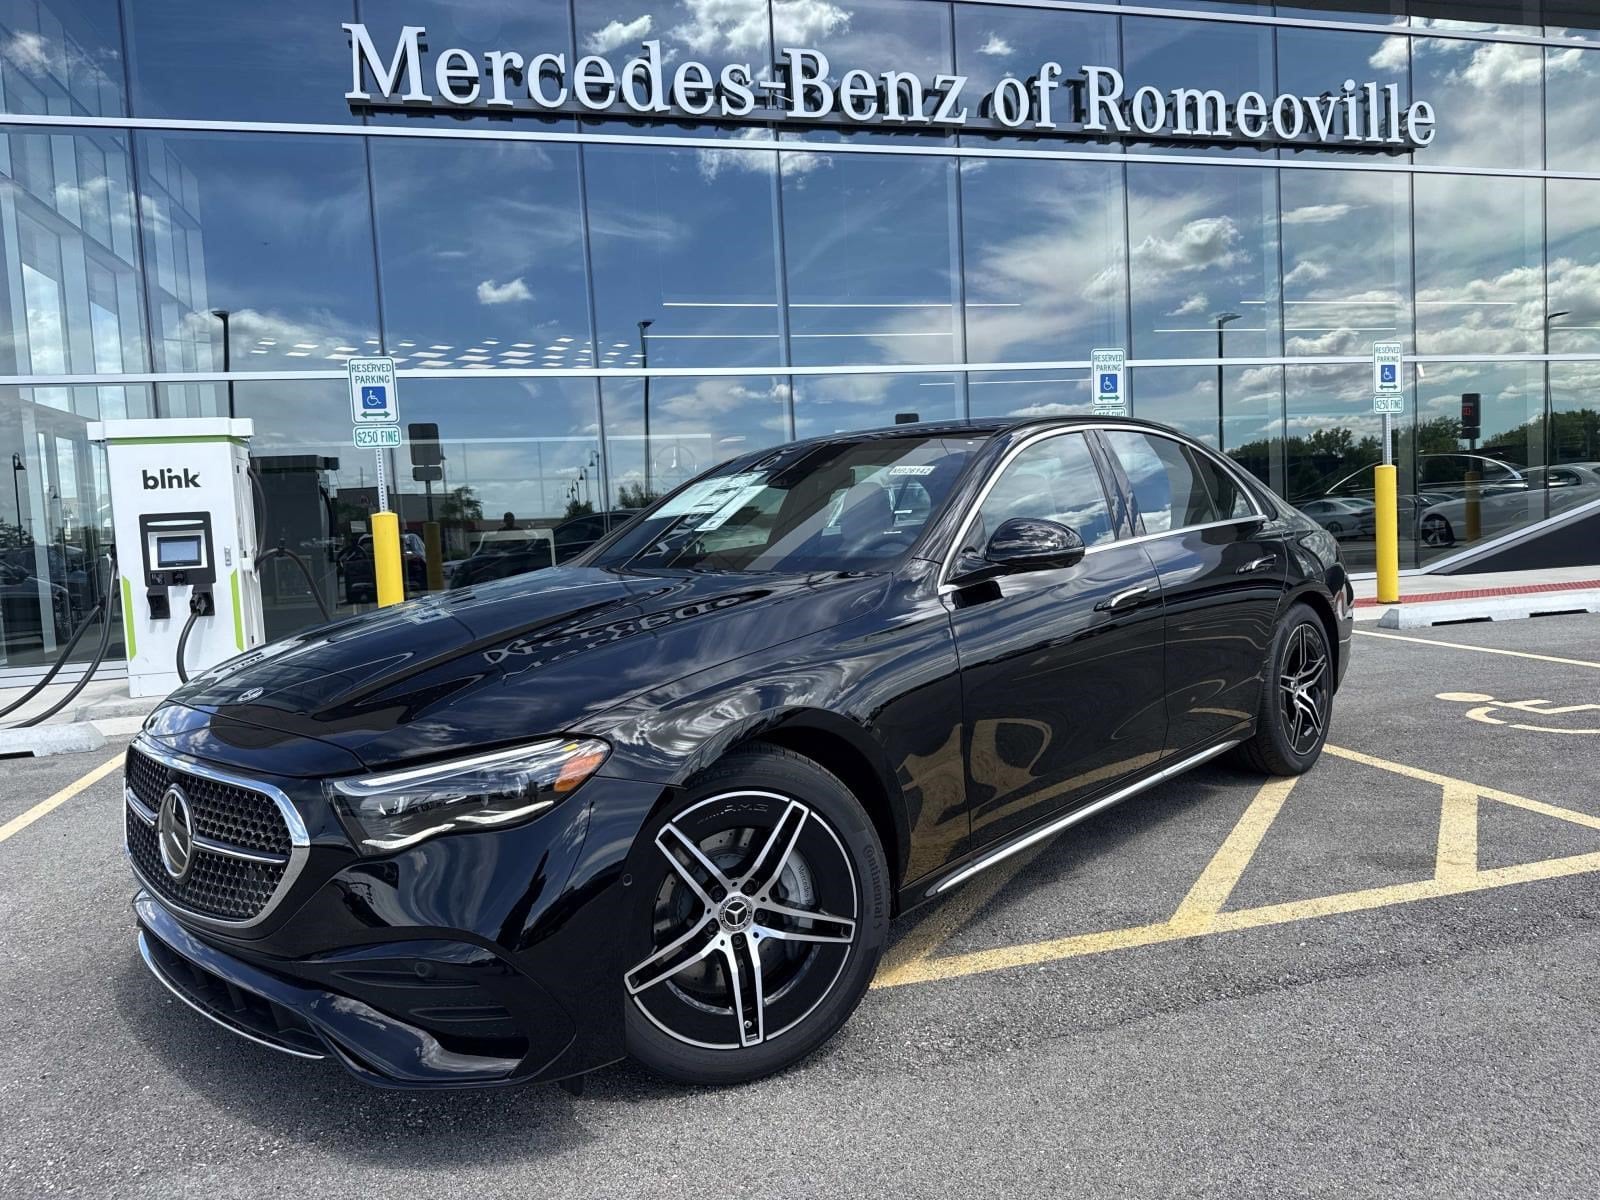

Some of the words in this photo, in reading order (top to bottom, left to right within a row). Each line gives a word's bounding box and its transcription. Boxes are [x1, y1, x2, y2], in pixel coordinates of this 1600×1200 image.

[341, 22, 968, 125] Mercedes-Benz
[993, 62, 1062, 128] of
[1081, 65, 1436, 147] Romeoville
[1375, 346, 1400, 354] RESERVED
[1094, 354, 1123, 362] RESERVED
[351, 363, 392, 373] RESERVED
[1096, 364, 1121, 372] PARKING
[355, 375, 390, 384] PARKING
[1376, 400, 1390, 410] $250
[1391, 400, 1401, 409] FINE
[357, 431, 378, 444] $250
[380, 430, 399, 443] FINE
[142, 468, 202, 490] blink
[862, 844, 884, 919] Continental
